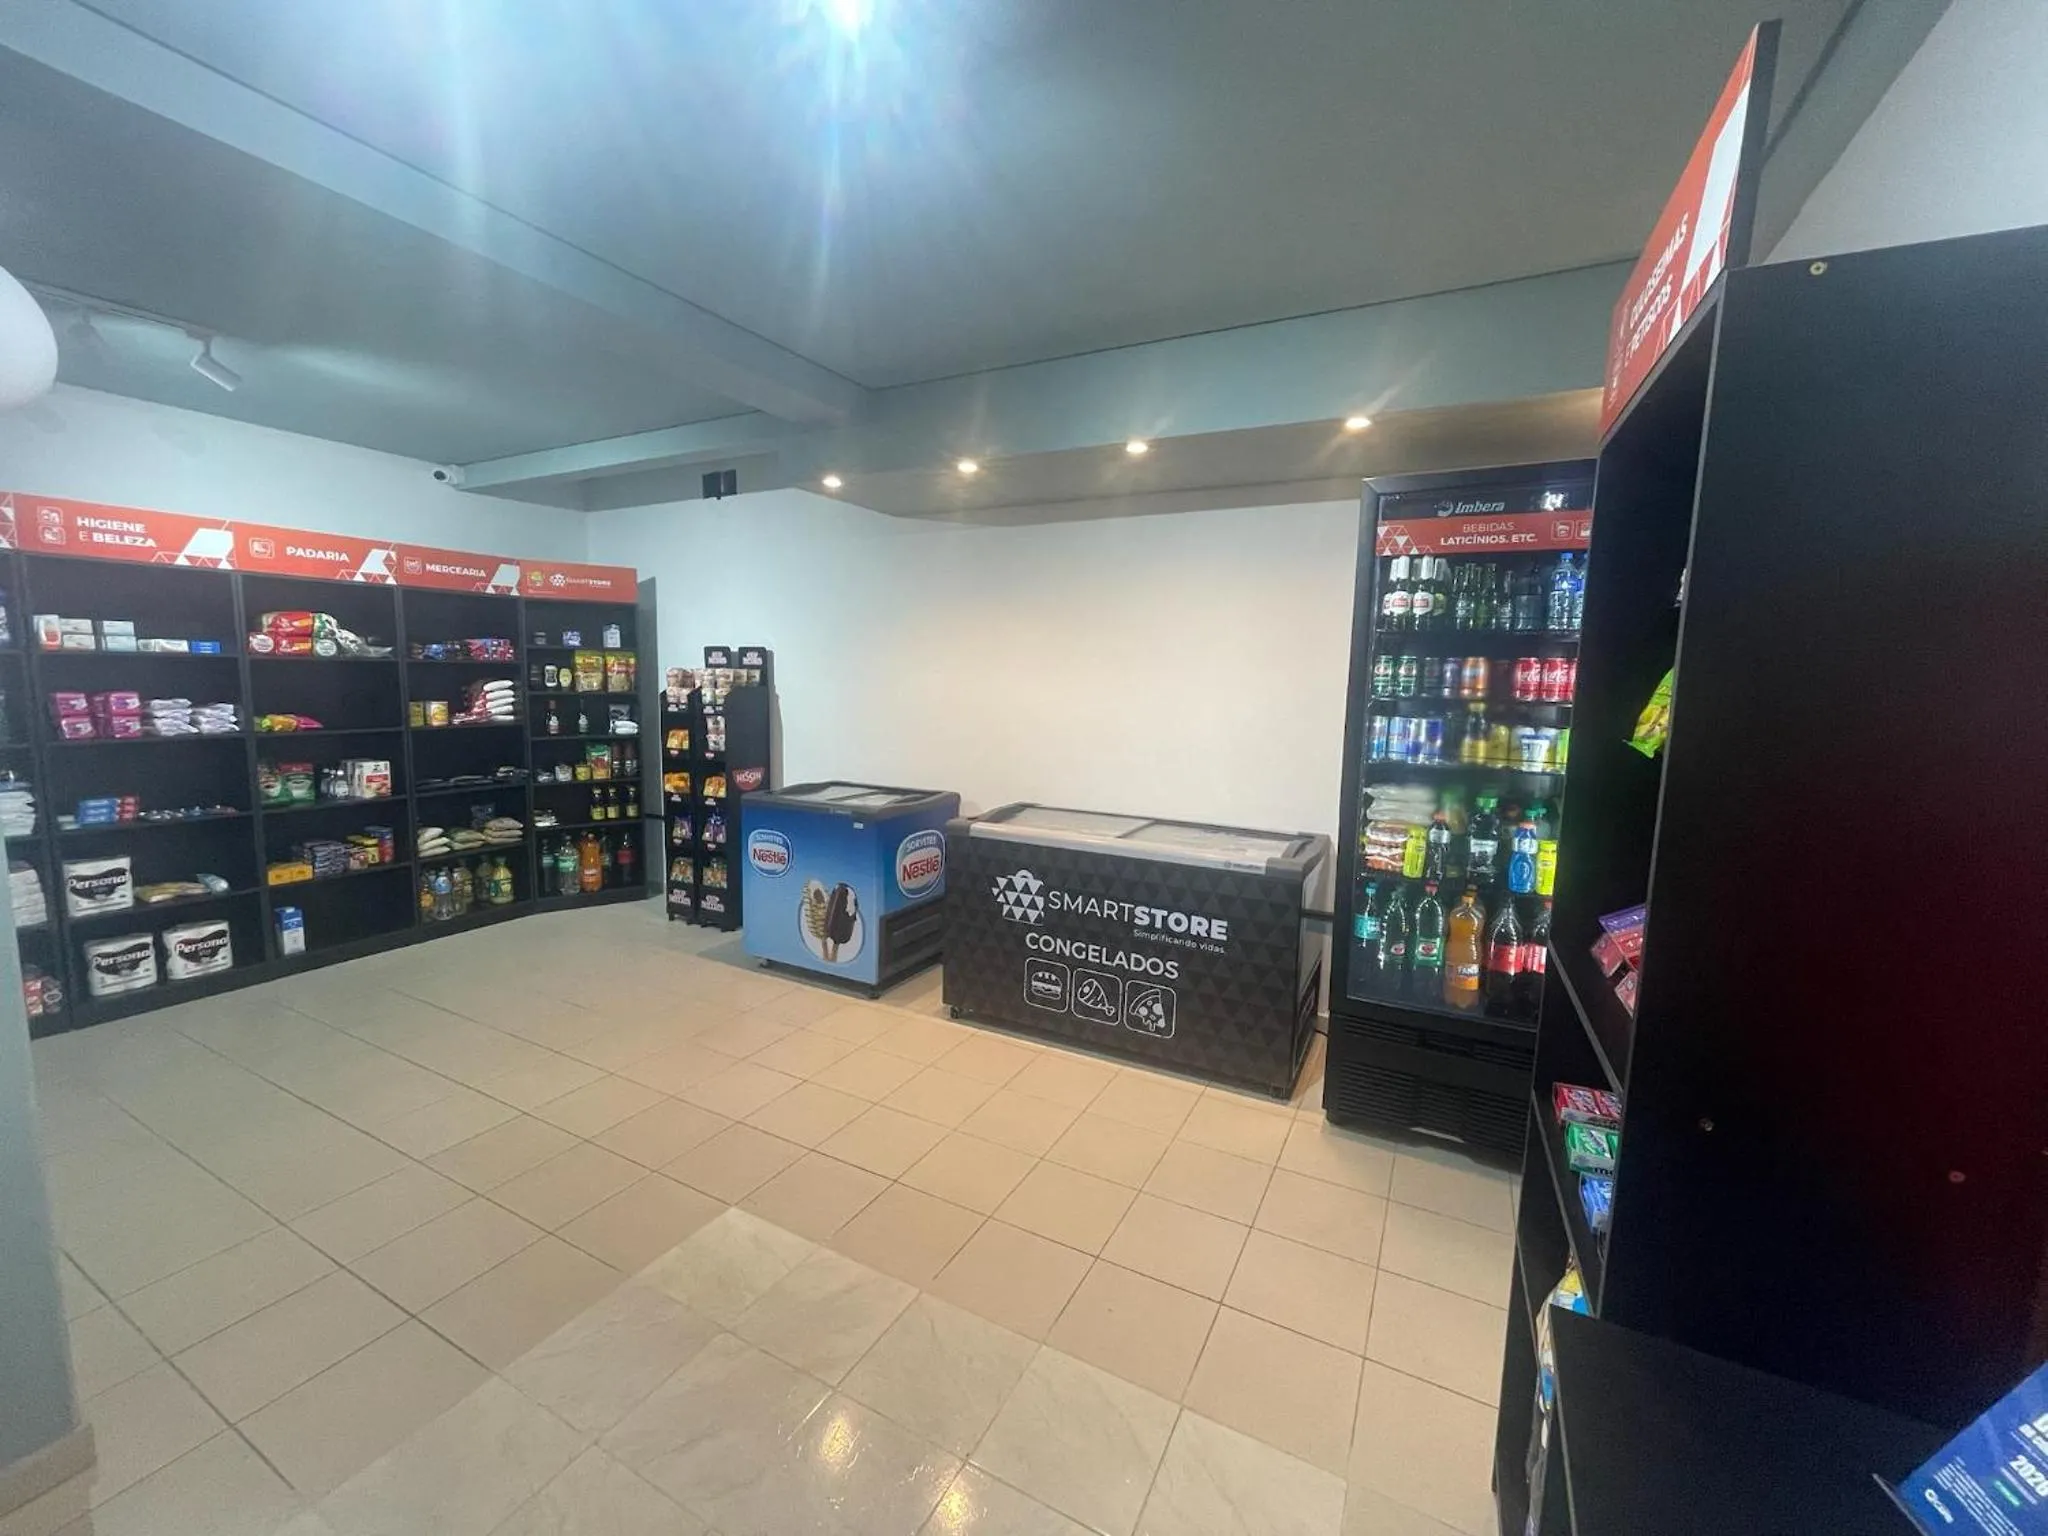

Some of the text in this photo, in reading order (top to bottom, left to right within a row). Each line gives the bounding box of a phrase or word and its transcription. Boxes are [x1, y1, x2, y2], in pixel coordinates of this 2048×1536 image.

[1455, 500, 1505, 514] Imbera
[76, 516, 147, 533] HIGIENE
[1463, 521, 1514, 533] BEBIDAS
[78, 530, 157, 547] E BELEZA
[1511, 533, 1538, 543] ETC.
[286, 546, 350, 562] PADARIA
[425, 563, 486, 577] MERCEARIA
[1048, 890, 1228, 941] SMARTSTORE
[1133, 928, 1197, 949] Simplificando
[1025, 932, 1180, 980] CONGELADOS
